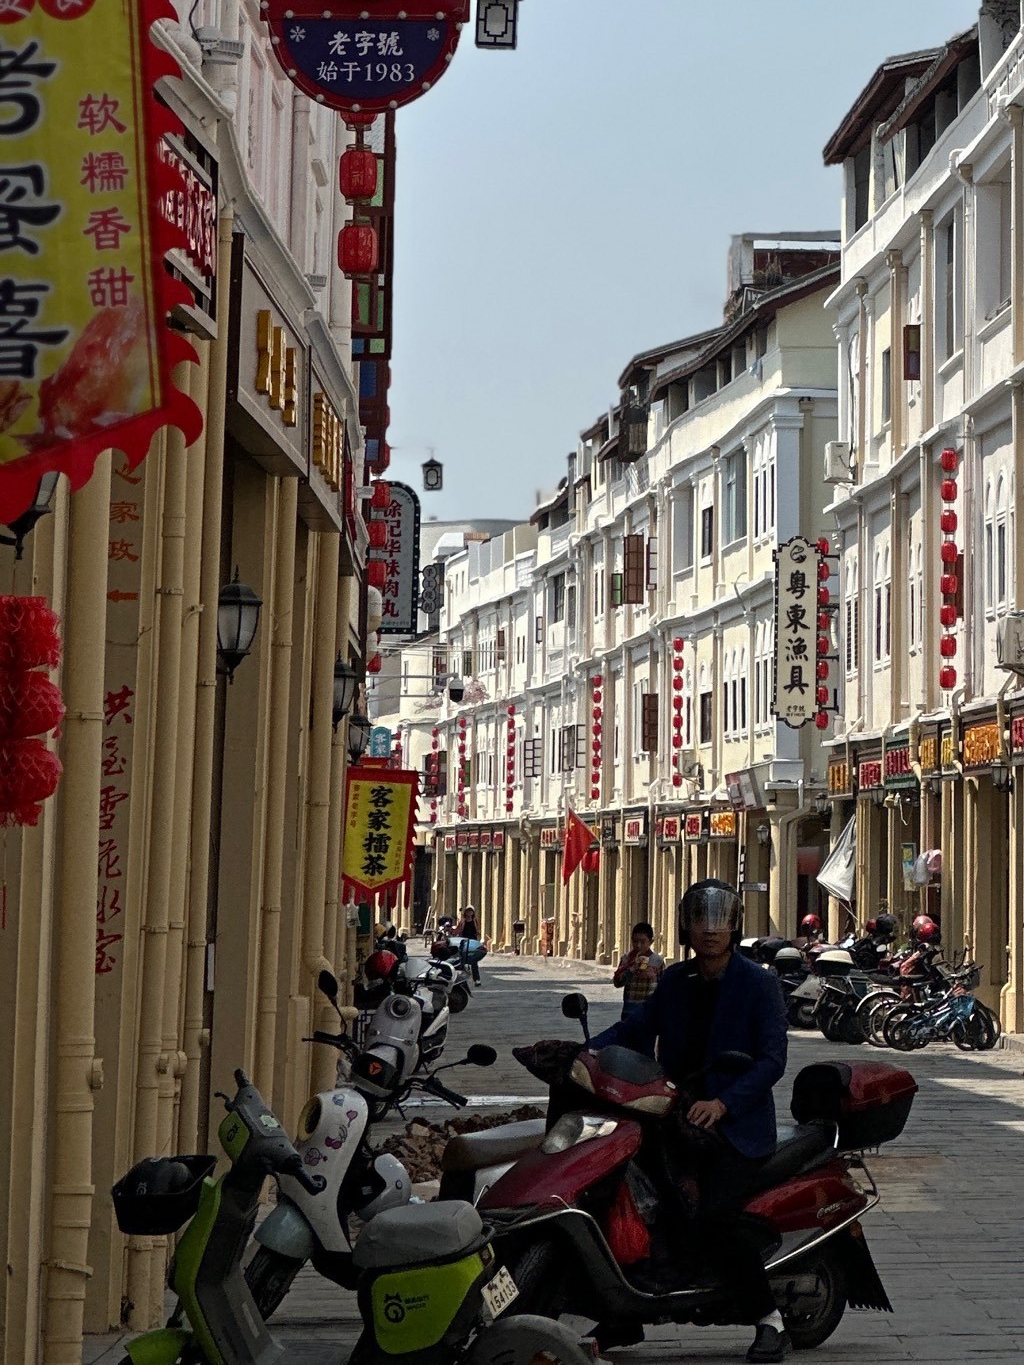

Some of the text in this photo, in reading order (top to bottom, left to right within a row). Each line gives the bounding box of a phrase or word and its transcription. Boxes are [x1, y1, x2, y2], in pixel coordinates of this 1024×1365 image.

[316, 61, 416, 82] 始于1983
[328, 31, 404, 56] 老字號
[77, 92, 135, 308] 软糯香甜
[360, 785, 395, 877] 客家擂茶
